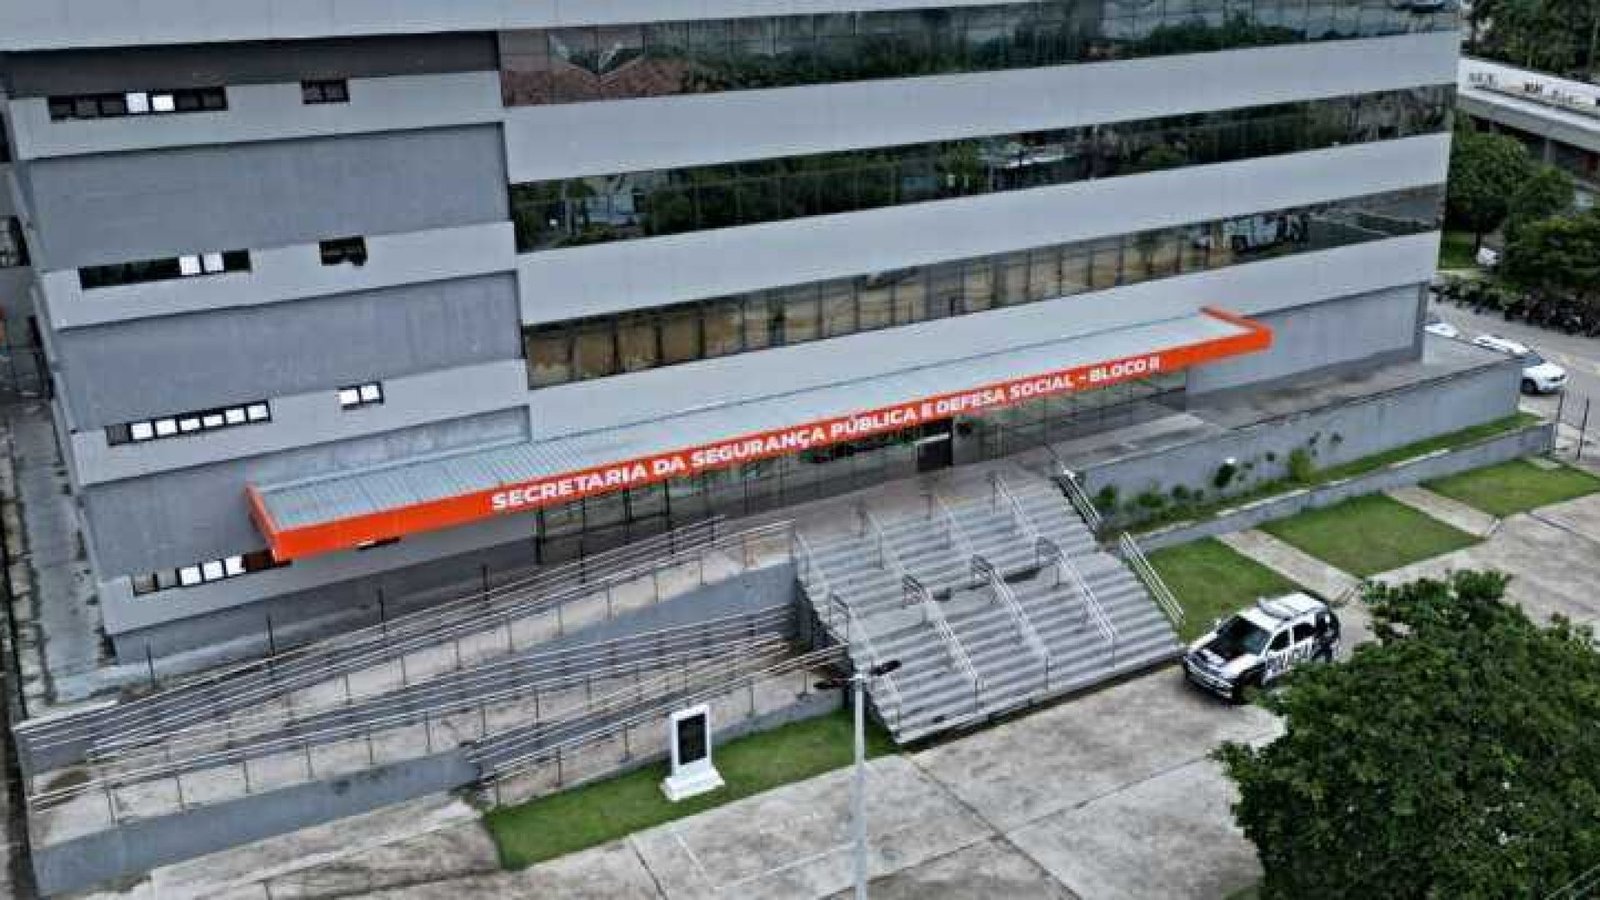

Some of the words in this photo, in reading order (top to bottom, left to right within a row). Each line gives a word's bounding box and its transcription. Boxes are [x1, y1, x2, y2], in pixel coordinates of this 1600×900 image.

[491, 463, 646, 510] SECRETARIA
[652, 457, 685, 474] DA
[691, 426, 825, 465] SEGURANÇA
[832, 408, 917, 436] PÚBLICA
[921, 401, 932, 417] E
[937, 386, 1005, 412] DEFESA
[1011, 376, 1074, 398] SOCIAL
[1089, 359, 1148, 382] BLOCO
[1150, 356, 1160, 371] II
